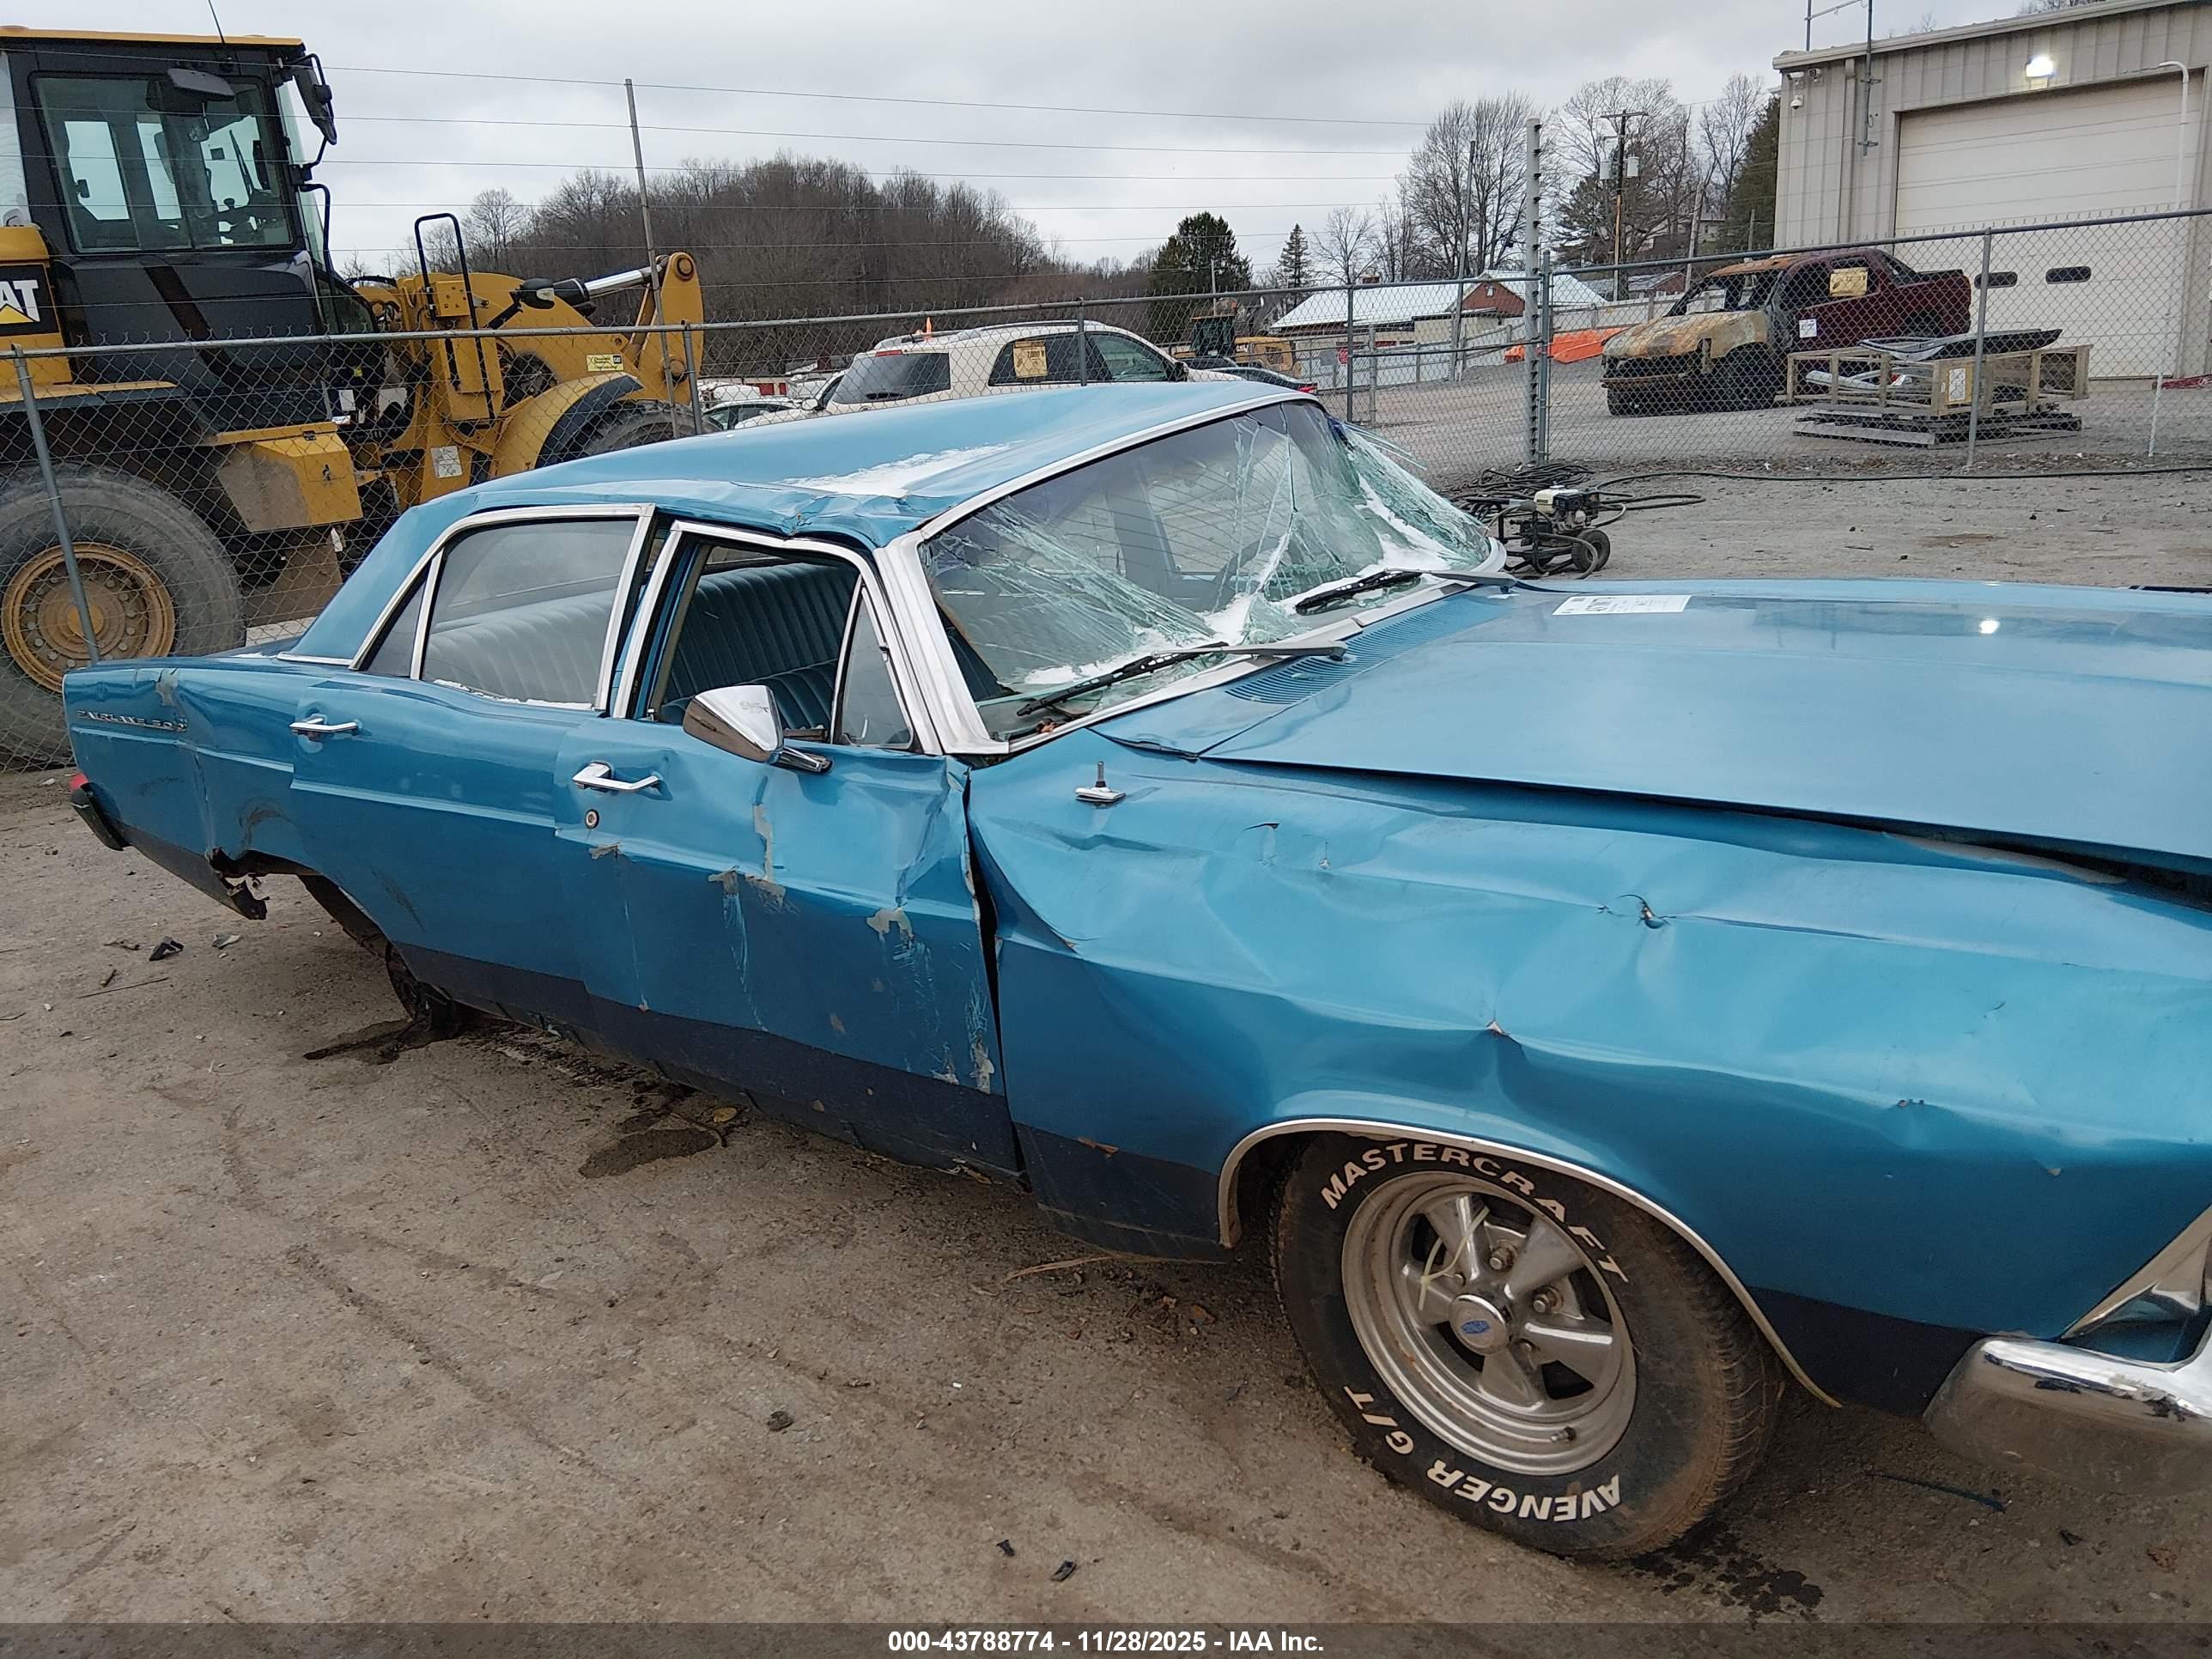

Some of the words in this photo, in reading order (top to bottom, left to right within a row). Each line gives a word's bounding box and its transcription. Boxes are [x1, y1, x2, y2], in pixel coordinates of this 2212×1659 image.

[0, 280, 40, 322] AT
[1321, 1143, 1629, 1283] MASTERCRAFT
[1343, 1386, 1414, 1455] G/T
[1426, 1460, 1621, 1522] AVENGER
